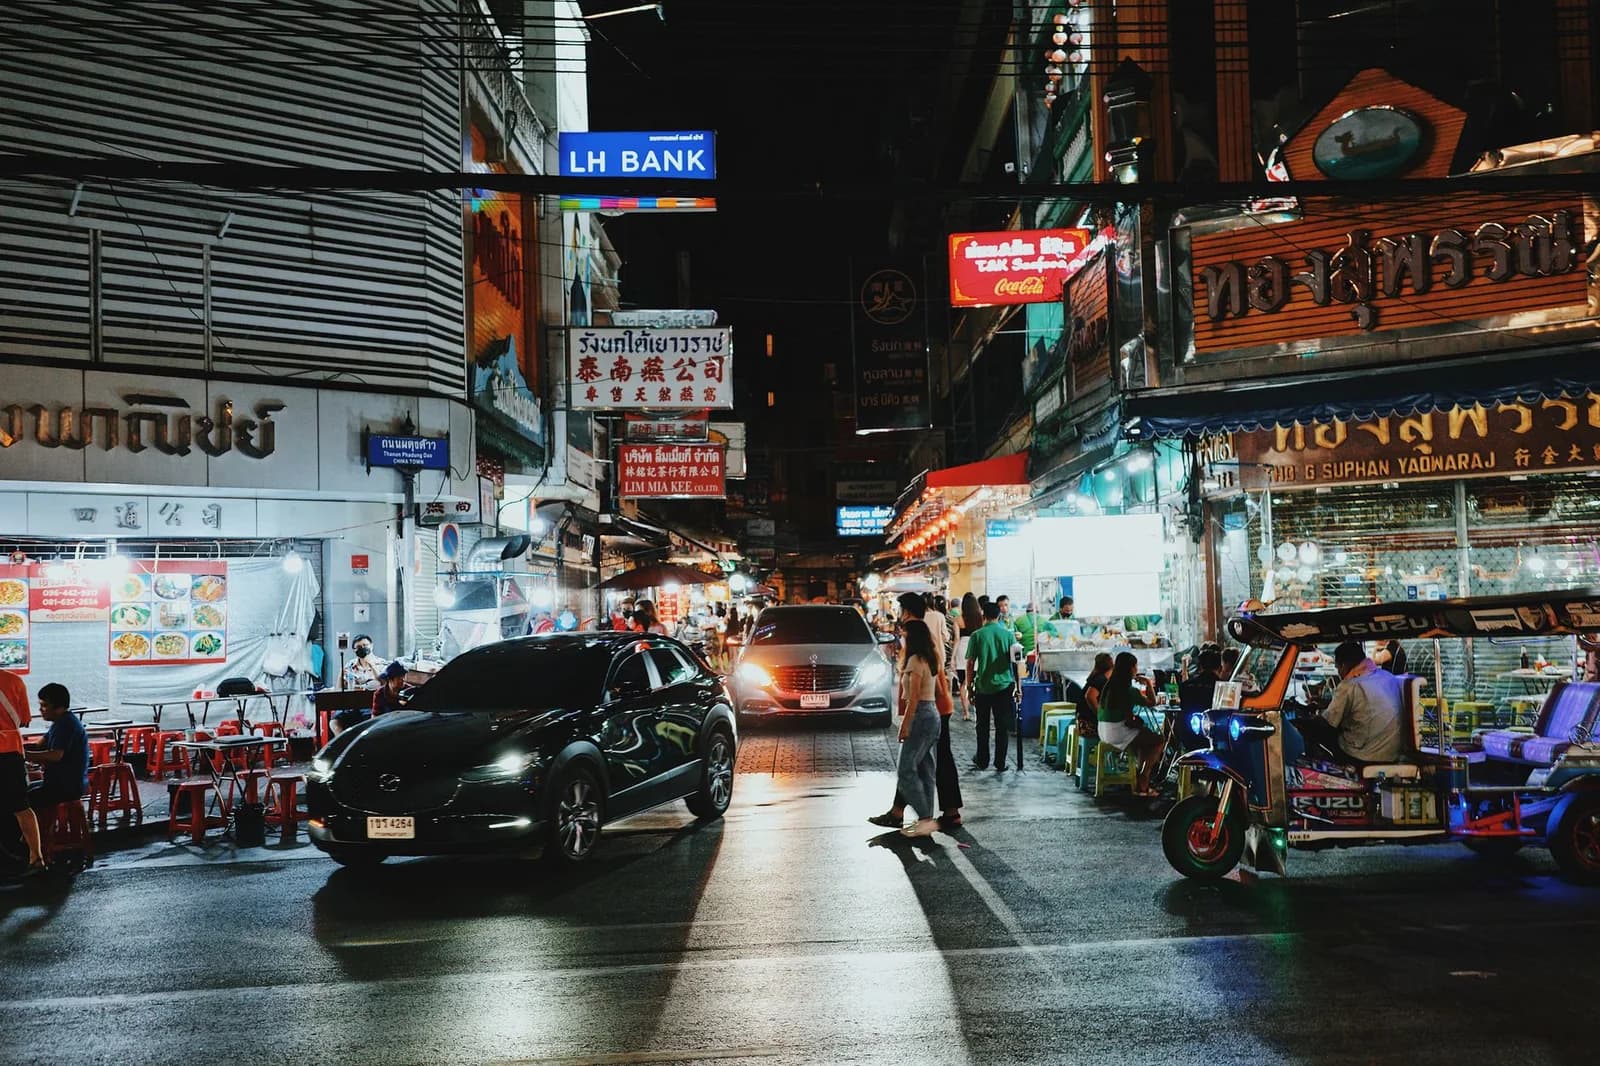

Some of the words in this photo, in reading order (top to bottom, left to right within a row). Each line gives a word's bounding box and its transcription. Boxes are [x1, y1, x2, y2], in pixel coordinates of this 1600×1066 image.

[569, 151, 606, 173] LH
[621, 149, 706, 173] BANK
[579, 330, 725, 354] รังนกใต้เยาวราช
[575, 355, 725, 384] 泰南燕公司
[1322, 459, 1390, 479] SUPHAN
[1397, 450, 1497, 475] YAOWARAJ
[625, 481, 645, 493] LIM
[647, 481, 668, 493] MIA
[671, 481, 692, 493] KEE
[1340, 615, 1429, 636] ISUZU
